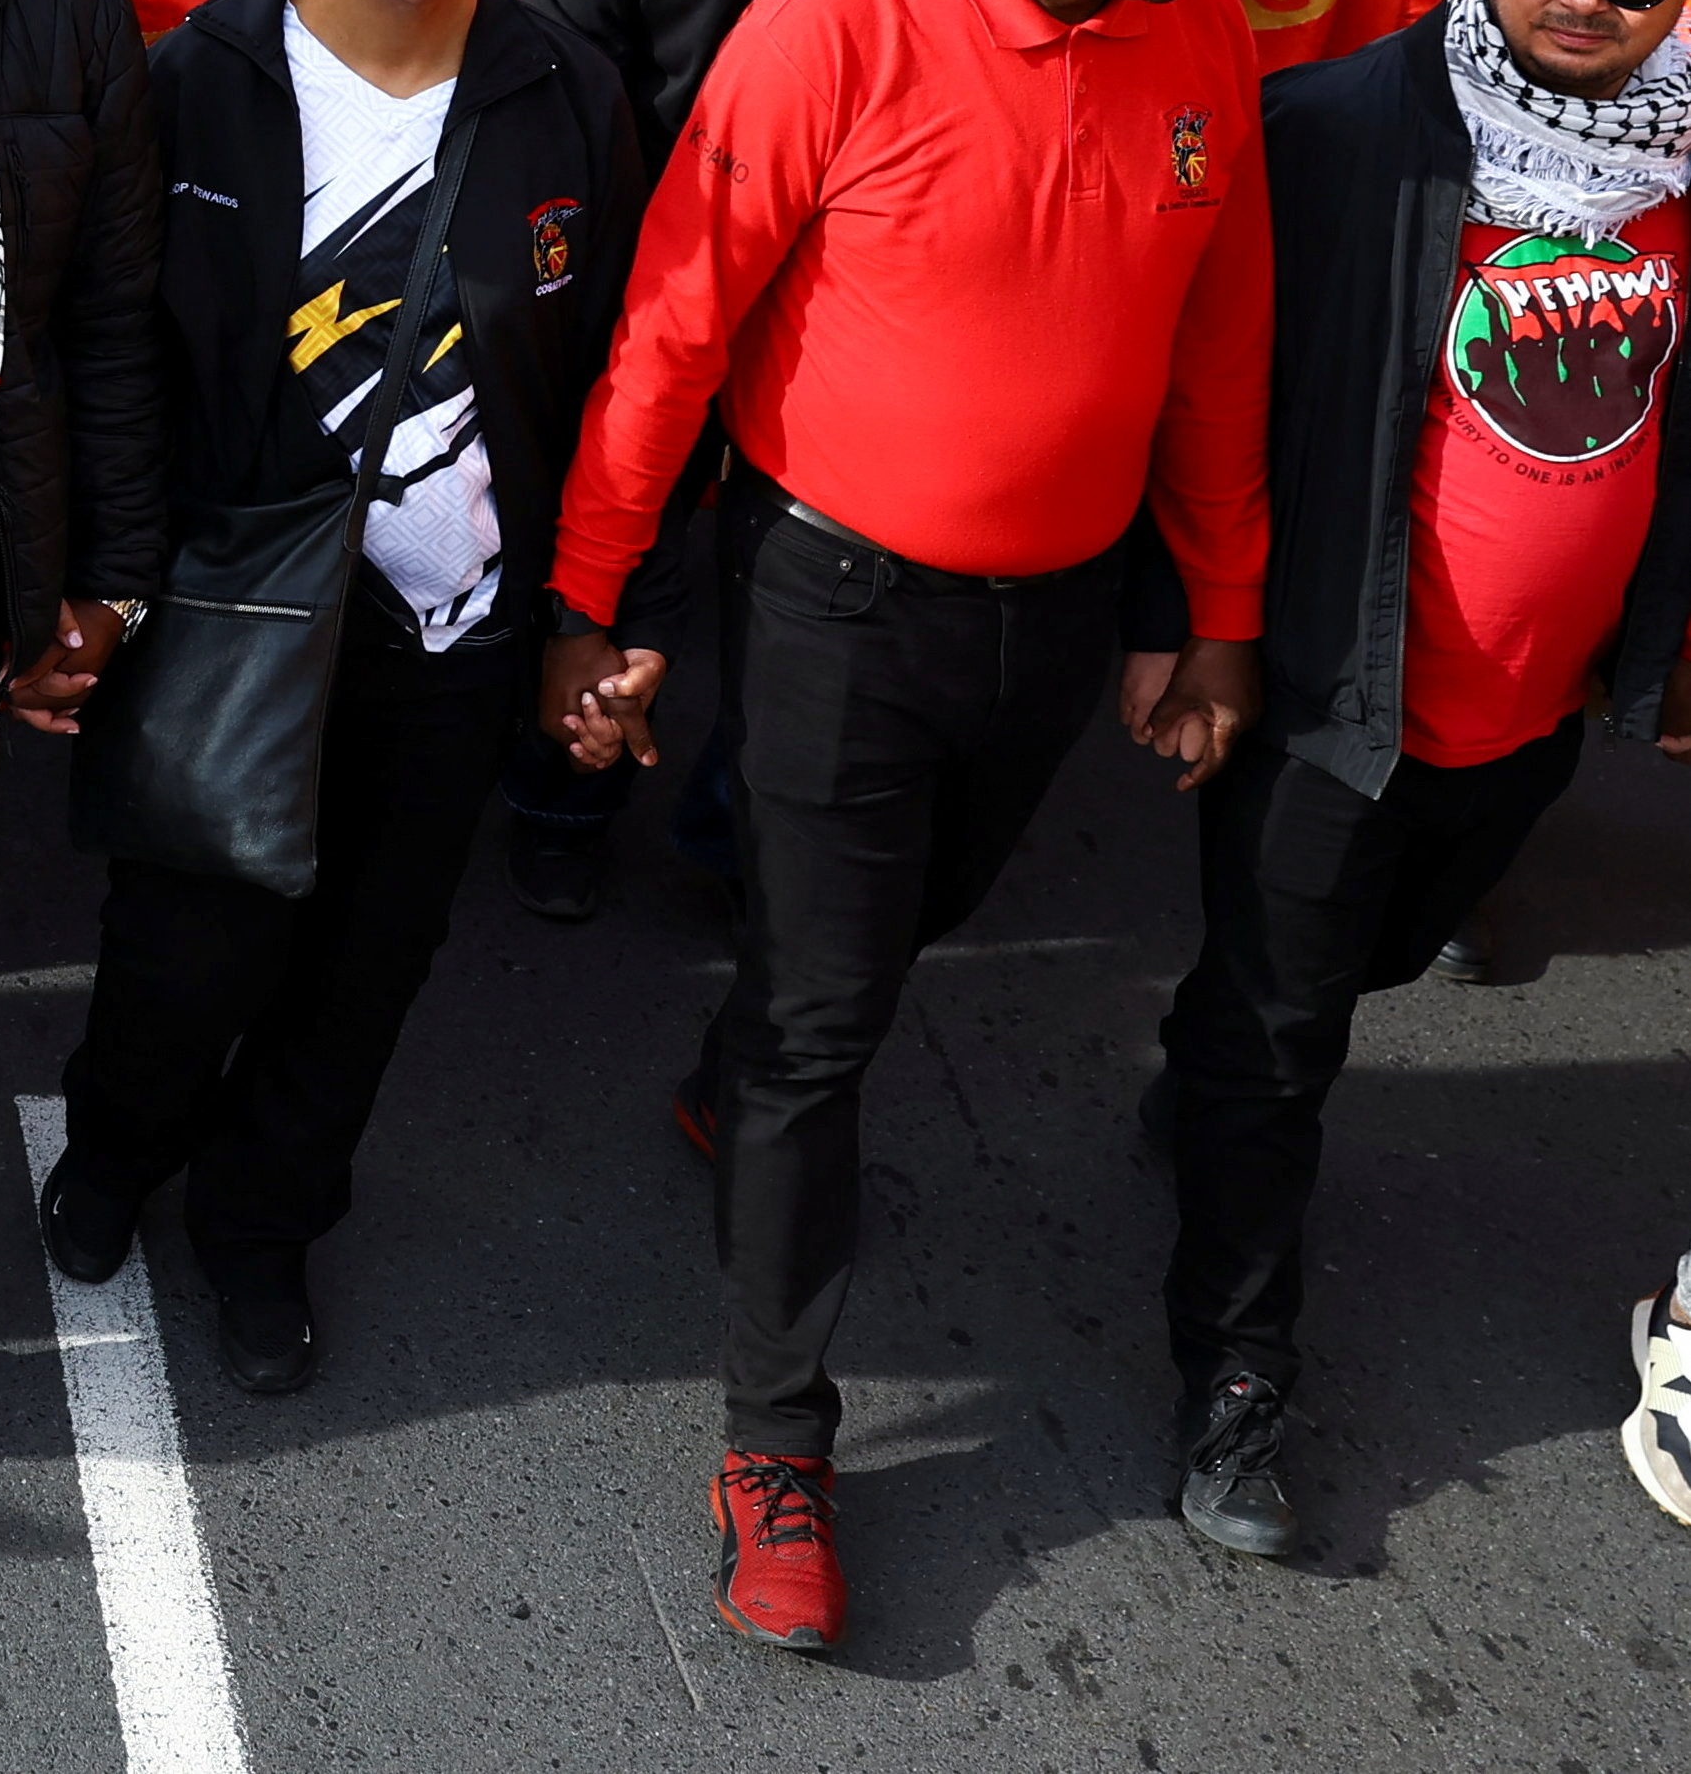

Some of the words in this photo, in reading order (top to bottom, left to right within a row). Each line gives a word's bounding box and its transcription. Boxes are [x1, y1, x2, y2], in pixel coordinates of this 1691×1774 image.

[1495, 258, 1671, 318] NEHAWU
[1488, 445, 1511, 467] TO
[1515, 461, 1552, 485] ONE
[1558, 468, 1576, 486] IS
[1581, 467, 1605, 484] AN
